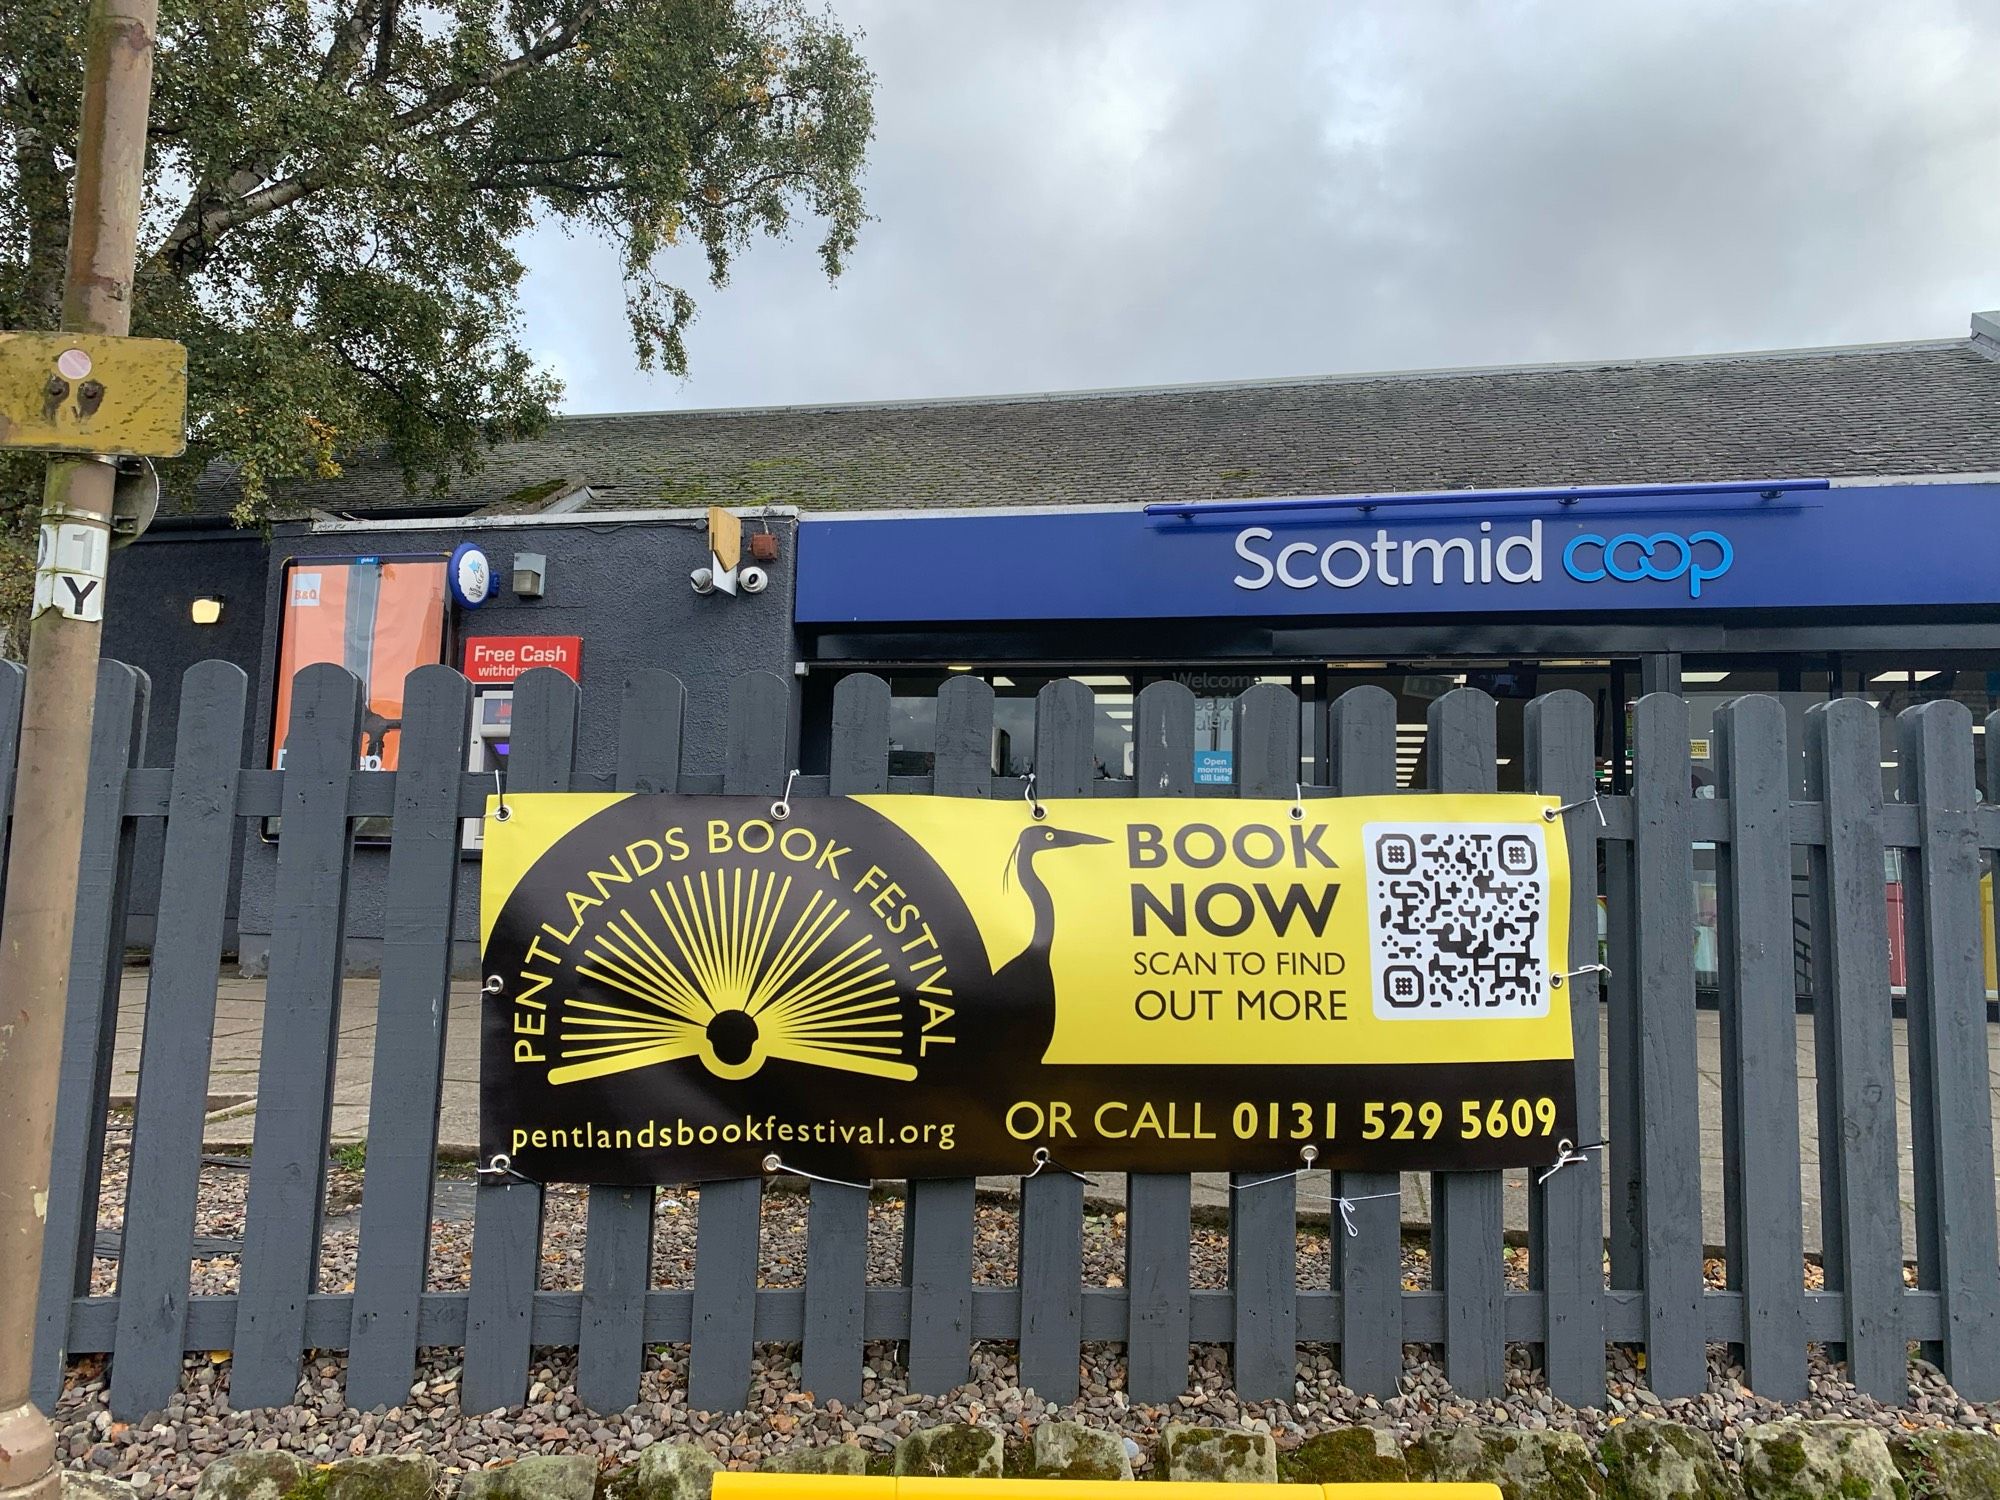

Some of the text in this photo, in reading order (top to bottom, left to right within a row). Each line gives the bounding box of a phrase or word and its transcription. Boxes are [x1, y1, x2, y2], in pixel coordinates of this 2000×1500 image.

[1234, 519, 1734, 598] Scotmid coop
[62, 576, 98, 615] Y
[294, 589, 318, 601] B&Q
[474, 645, 567, 663] Free Cash
[1197, 766, 1233, 776] morning
[1200, 774, 1230, 782] till late
[1203, 758, 1227, 766] Open
[1126, 822, 1340, 870] BOOK
[1131, 883, 1341, 938] NOW
[513, 818, 956, 1063] PENTLANDS BOOK FESTIVAL
[1133, 952, 1346, 976] SCAN TO FIND
[1134, 989, 1348, 1021] OUT MORE
[511, 1115, 956, 1156] pentlandsbookfestival.org
[1005, 1097, 1556, 1140] OR CALL 0131 529 5609
